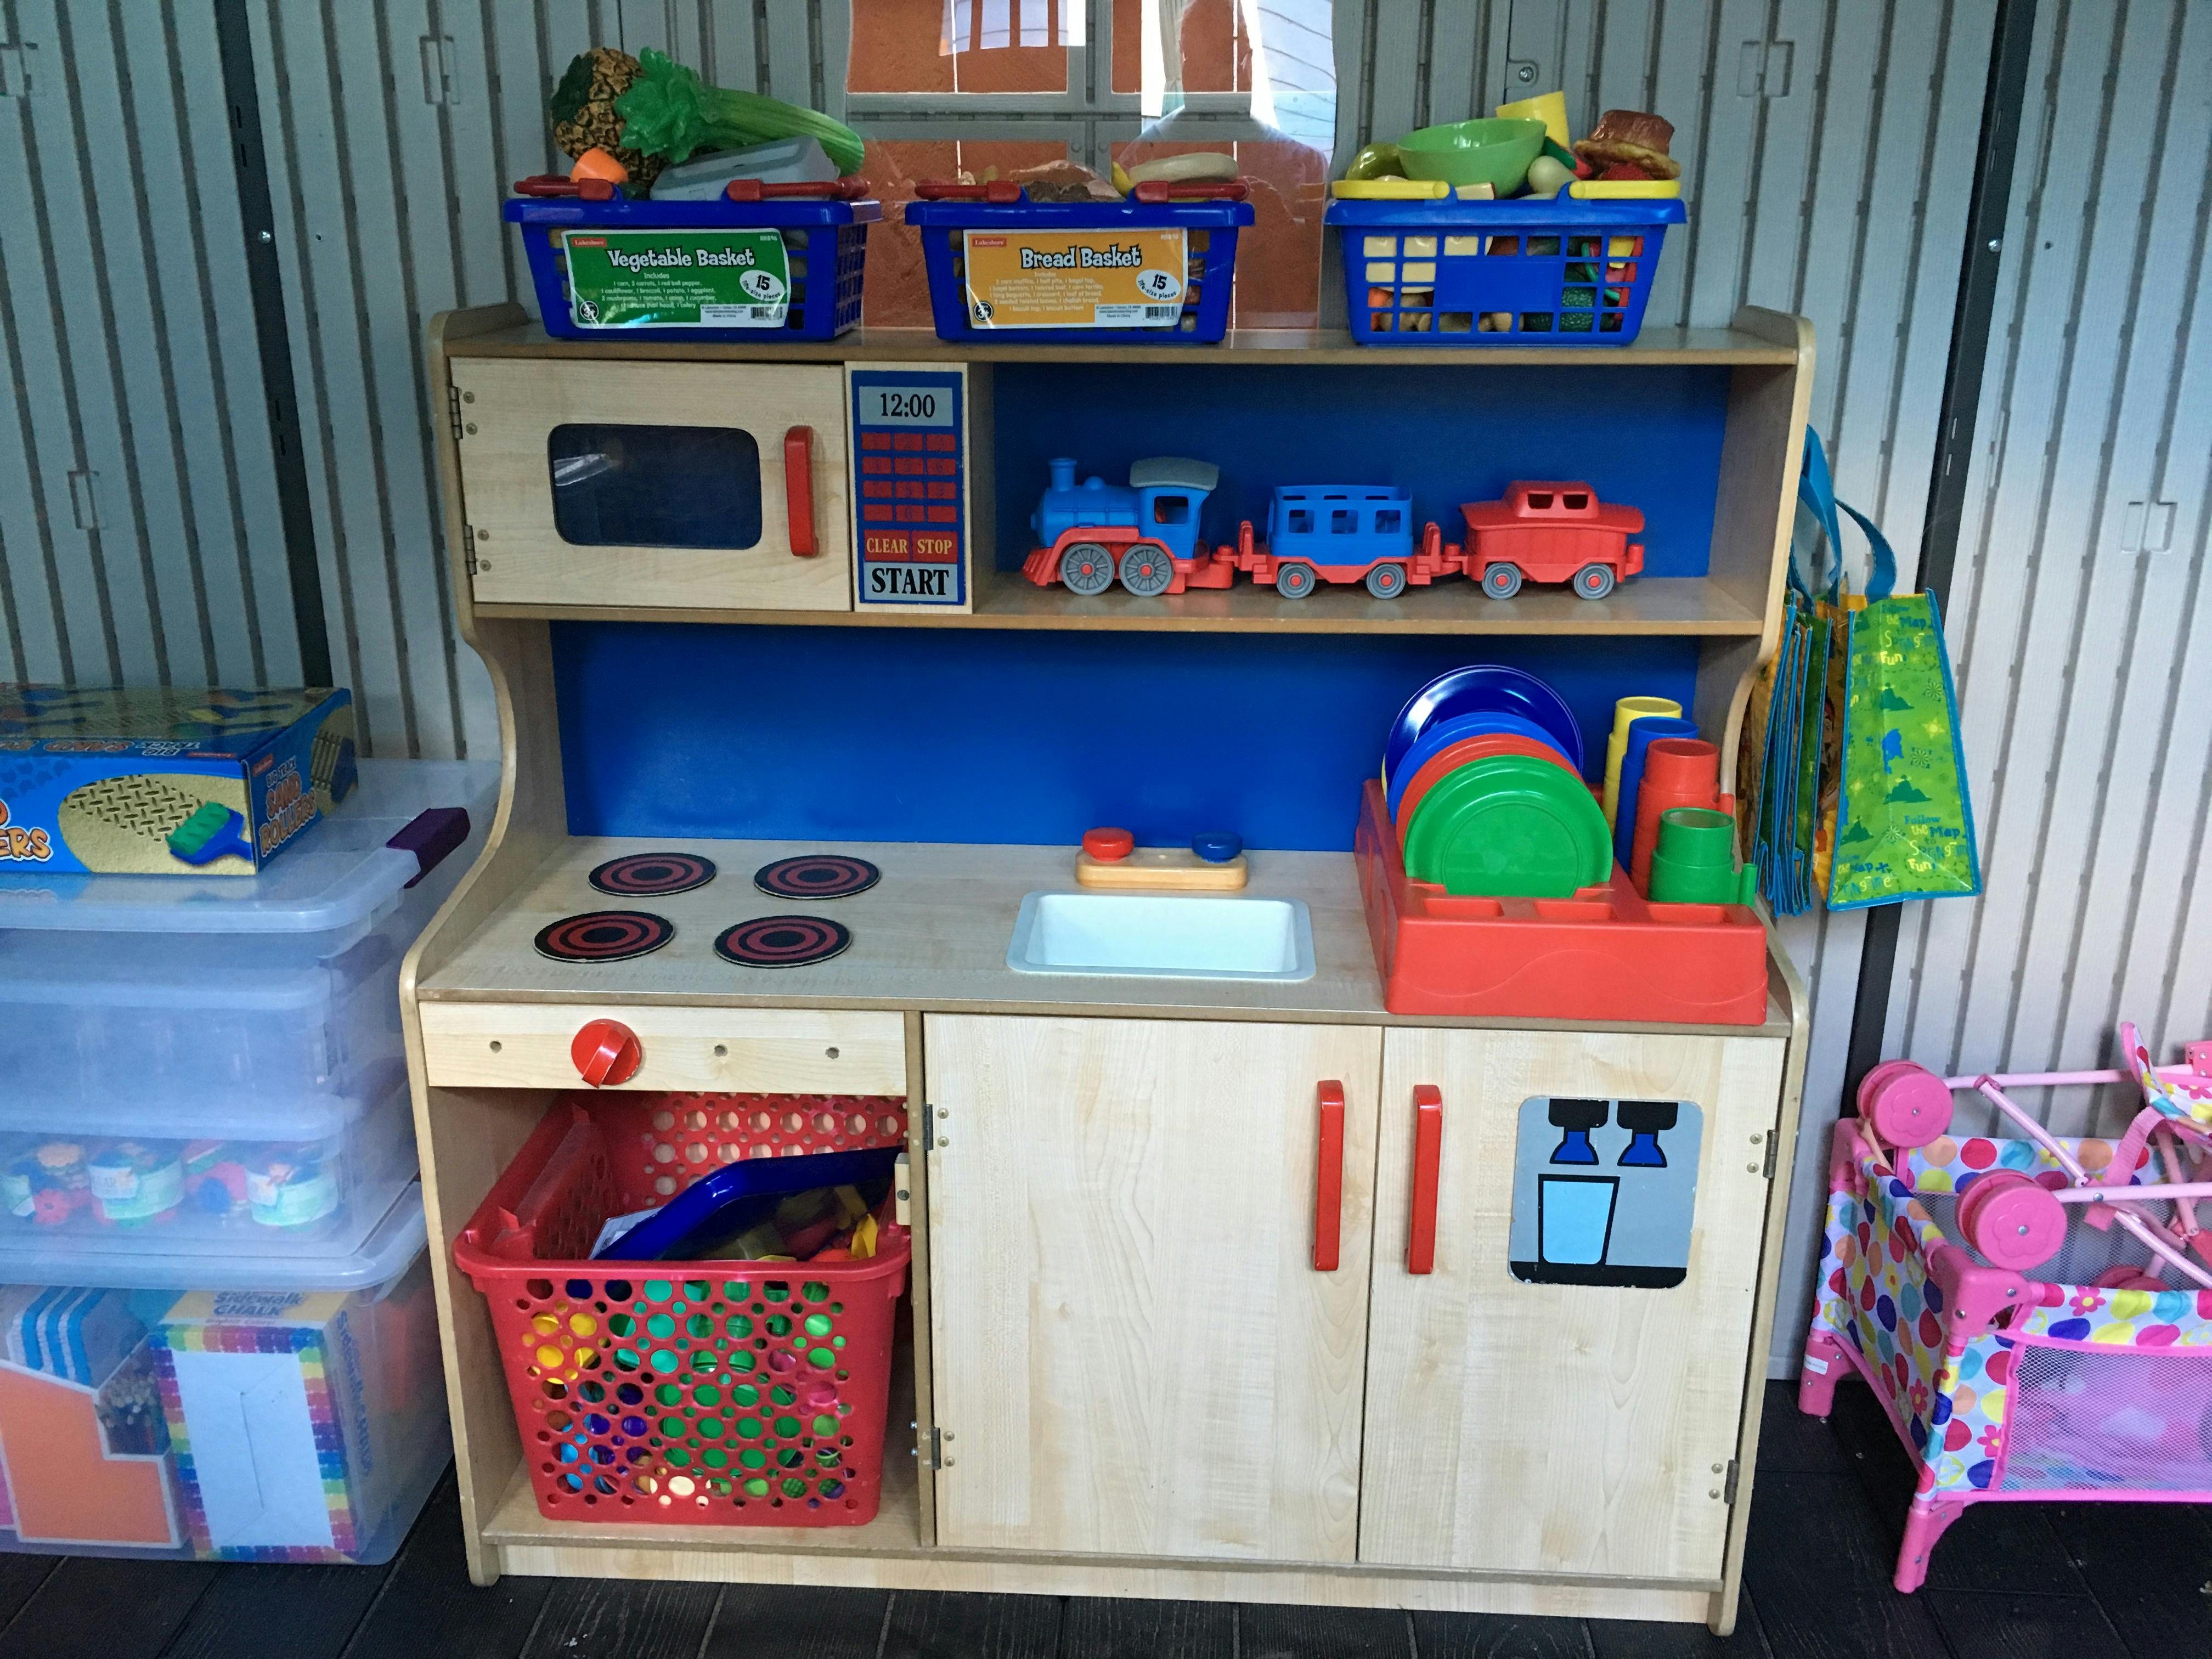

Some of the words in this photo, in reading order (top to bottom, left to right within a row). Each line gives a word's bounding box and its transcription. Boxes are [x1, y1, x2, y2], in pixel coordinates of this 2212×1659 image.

[606, 247, 692, 273] Vegetable
[696, 247, 755, 267] Basket
[1020, 246, 1076, 268] Bread
[1080, 245, 1142, 268] Basket
[755, 274, 770, 291] 15
[1152, 274, 1167, 290] 15
[1158, 290, 1177, 300] pieces
[880, 393, 936, 419] 12:00
[866, 537, 908, 554] CLEAR
[917, 539, 953, 555] STOP
[871, 567, 949, 596] START
[266, 771, 301, 821] SAND
[259, 787, 317, 857] ROLLERS
[1929, 826, 1960, 839] Map
[213, 1290, 303, 1305] Sidewalk
[213, 1305, 280, 1317] CHALK
